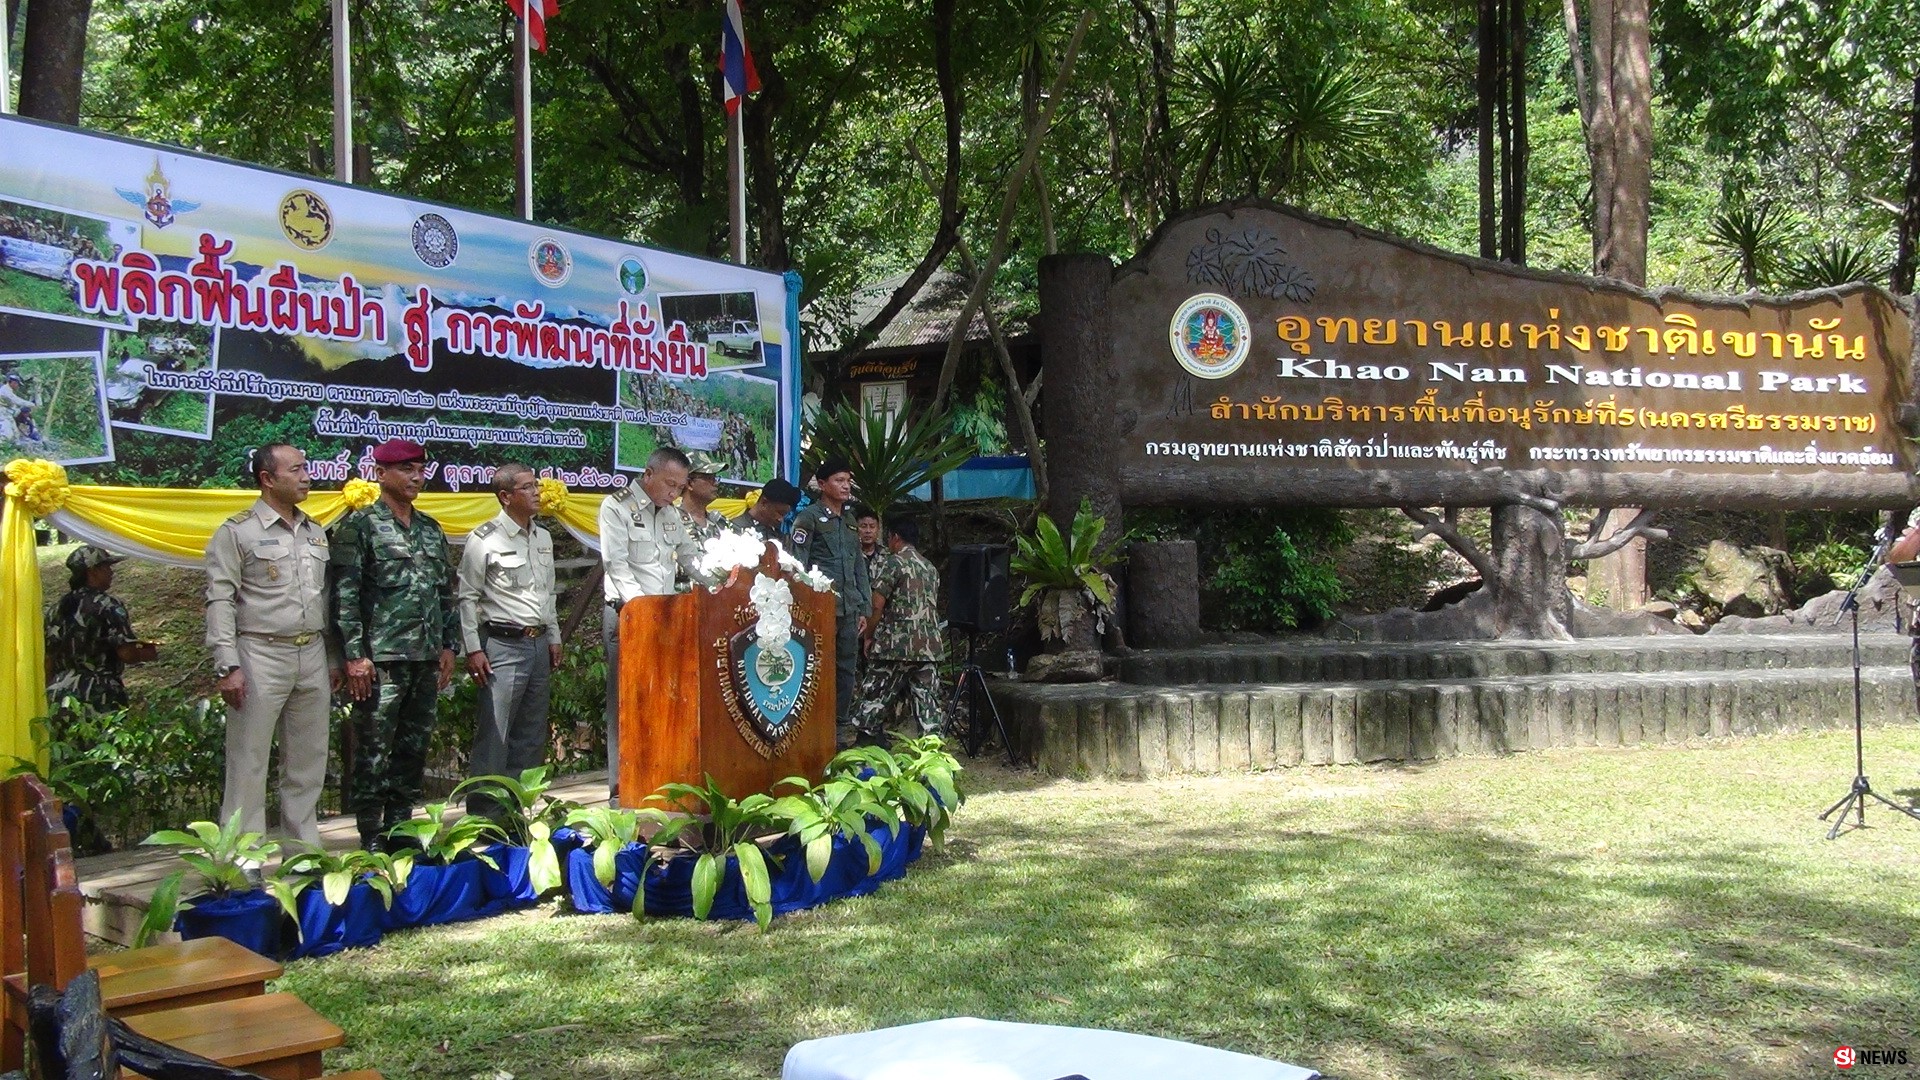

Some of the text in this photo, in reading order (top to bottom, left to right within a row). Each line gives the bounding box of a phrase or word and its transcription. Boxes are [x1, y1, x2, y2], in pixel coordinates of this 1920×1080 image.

[75, 232, 386, 341] พลิกฟื้นผืนป่า
[403, 287, 430, 368] สู่
[447, 301, 707, 378] การพัฒนาที่ยั่งยืน
[1275, 308, 1867, 361] อุทยานแห่งชาติเขานัน
[1276, 357, 1867, 394] Khao Nan National Park
[327, 385, 400, 405] ตามมาตรา
[402, 391, 434, 406] ๒๒
[440, 391, 622, 421] แห่งพระราชบัญญัติอุทยานแห่งชาติ
[1210, 387, 1877, 433] สำนักบริหารพื้นที่อนุรักษ์ที่5(นครศรีธรรมราช)
[1145, 433, 1894, 466] กรมอุทยานแห่งชาติสัตว์ป่าและพันธุ์พืช กระทรวงทรัพยากรธรรมชาติและสิ่งแวดล้อม
[737, 653, 815, 737] NATIONAL PARK THAILAND
